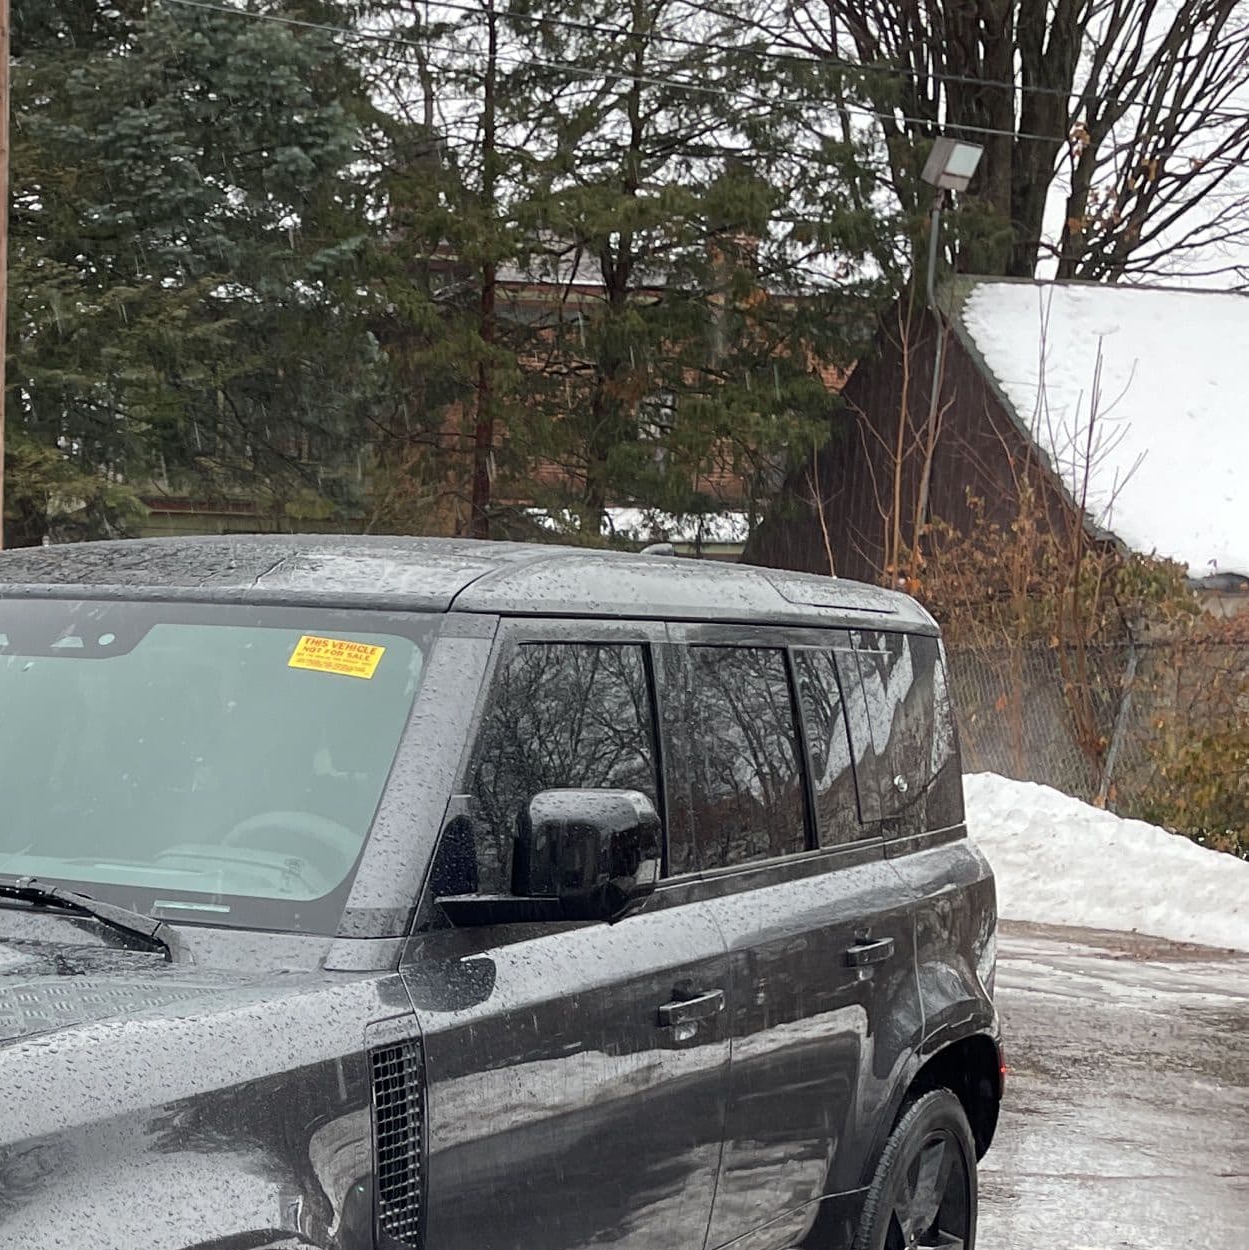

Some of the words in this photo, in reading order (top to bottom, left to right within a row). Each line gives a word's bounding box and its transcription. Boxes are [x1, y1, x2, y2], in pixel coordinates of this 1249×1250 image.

[304, 638, 328, 647] THIS
[332, 641, 377, 655] VEHICLE
[324, 648, 344, 657] FOR
[347, 653, 371, 661] SALE
